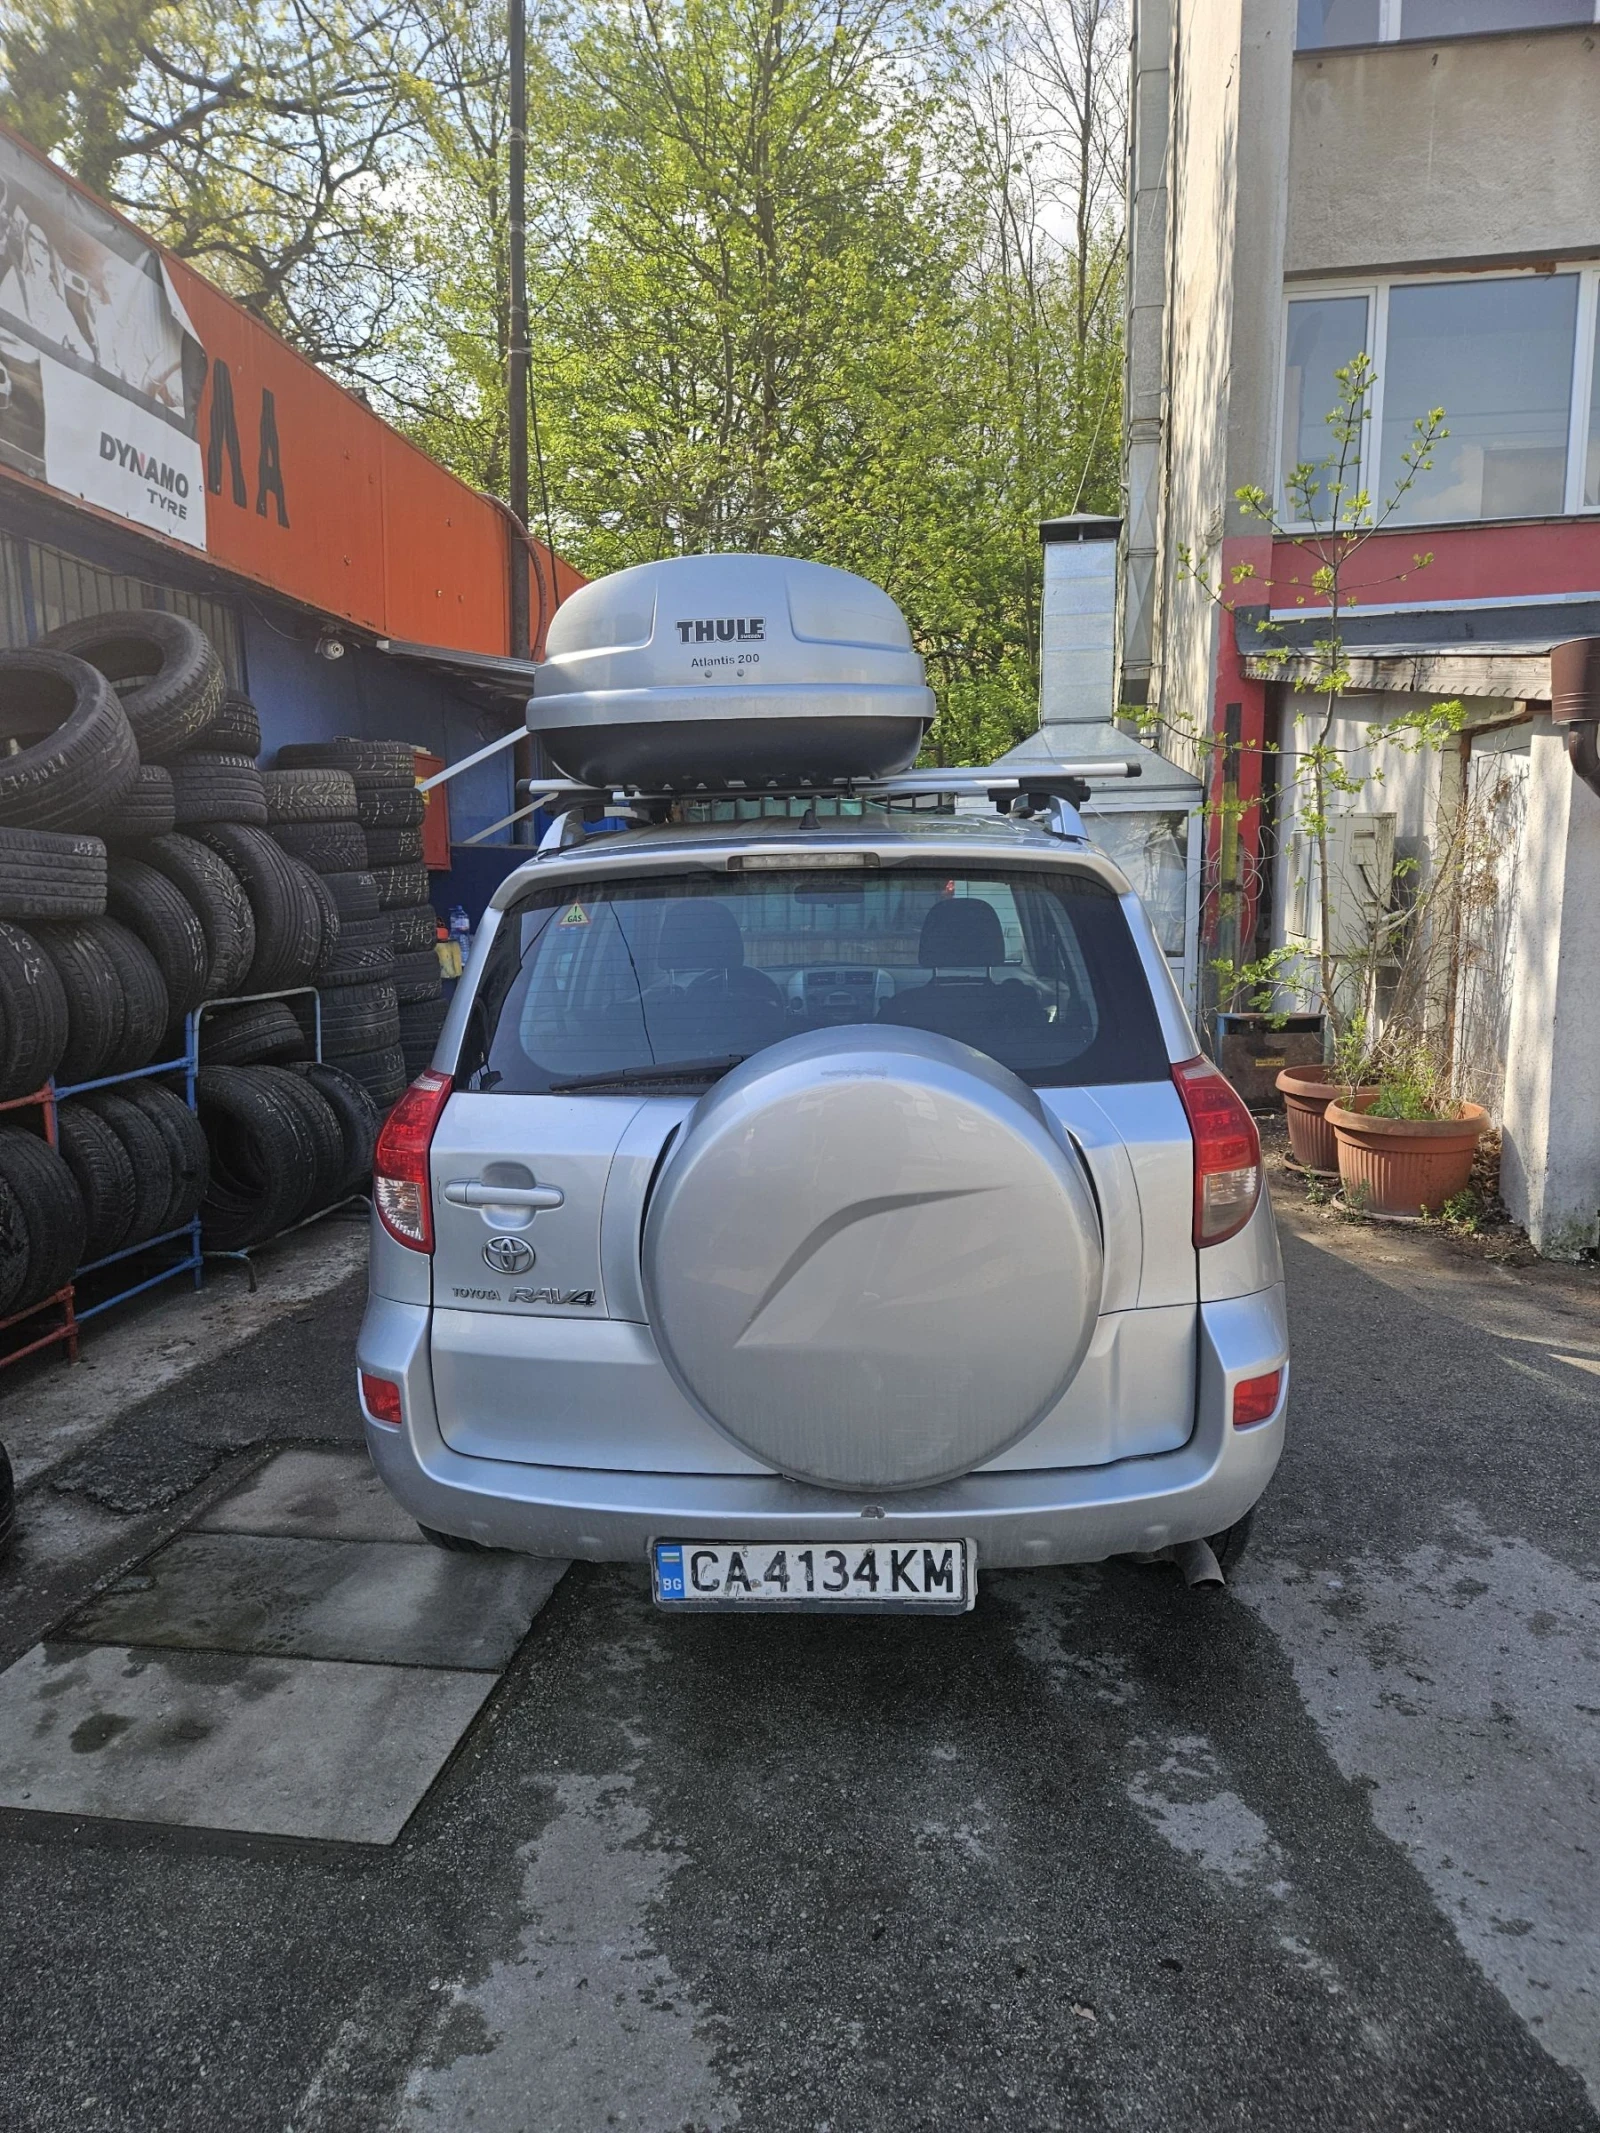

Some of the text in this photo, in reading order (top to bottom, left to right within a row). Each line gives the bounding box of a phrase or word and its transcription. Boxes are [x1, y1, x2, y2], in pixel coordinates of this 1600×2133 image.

[99, 431, 190, 499] DYNAMO
[147, 487, 188, 521] TYRE
[676, 618, 765, 642] THULE
[691, 653, 760, 668] Atlantis 200
[567, 914, 582, 922] GAS
[452, 1285, 597, 1308] TOYOTA RAV4
[662, 1576, 682, 1592] BG
